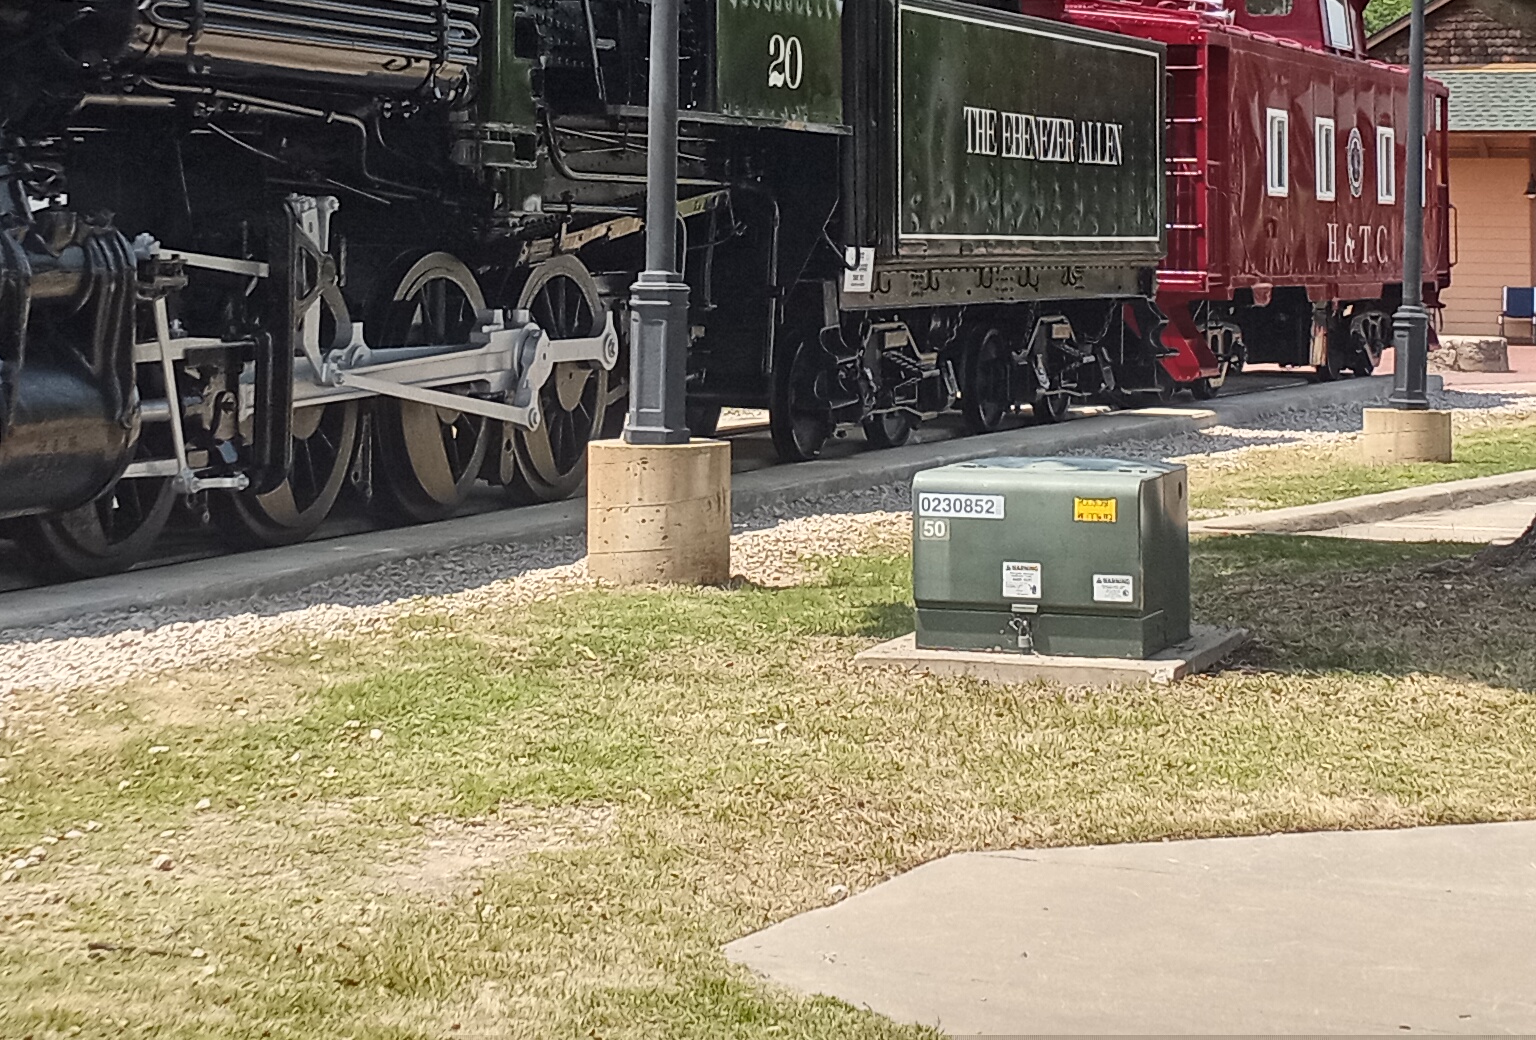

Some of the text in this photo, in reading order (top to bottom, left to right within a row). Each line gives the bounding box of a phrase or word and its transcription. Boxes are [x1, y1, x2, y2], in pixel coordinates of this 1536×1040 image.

[768, 34, 803, 89] 20
[963, 106, 1123, 166] THE EBENEZER ALLEN
[1344, 223, 1355, 263] &
[921, 496, 995, 515] 0230852
[923, 519, 946, 538] 50
